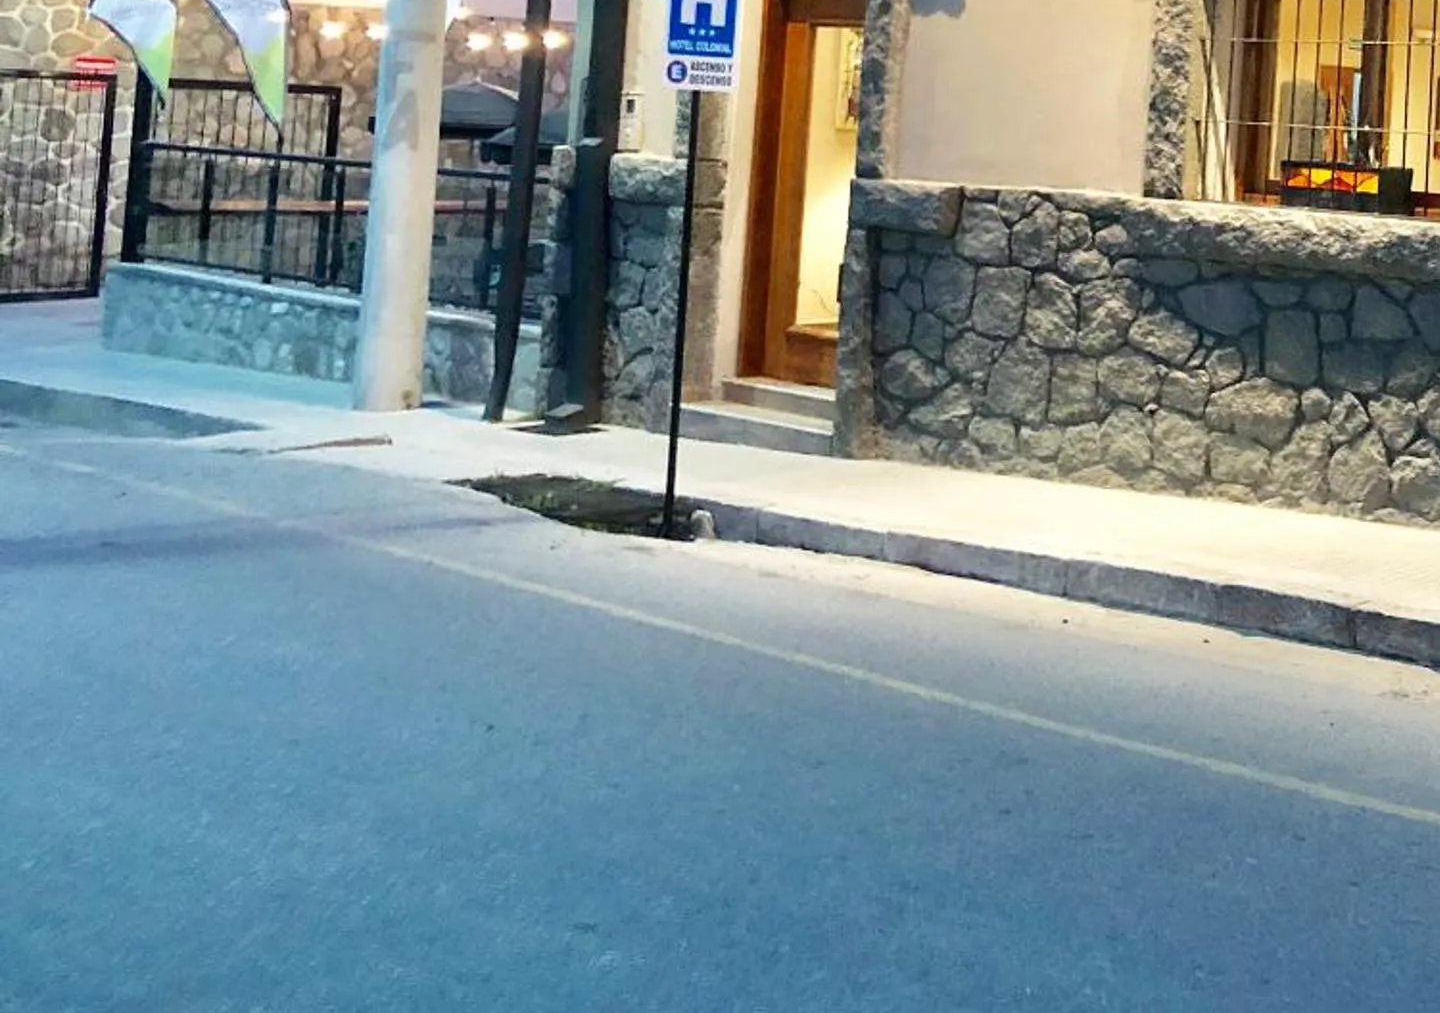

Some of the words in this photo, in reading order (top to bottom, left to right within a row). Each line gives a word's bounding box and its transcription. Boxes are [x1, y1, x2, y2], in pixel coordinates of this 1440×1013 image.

[669, 39, 694, 51] HOTEL
[695, 41, 732, 54] COLONIAL
[690, 60, 726, 73] ASCENSO
[689, 74, 732, 86] DESCENSO
